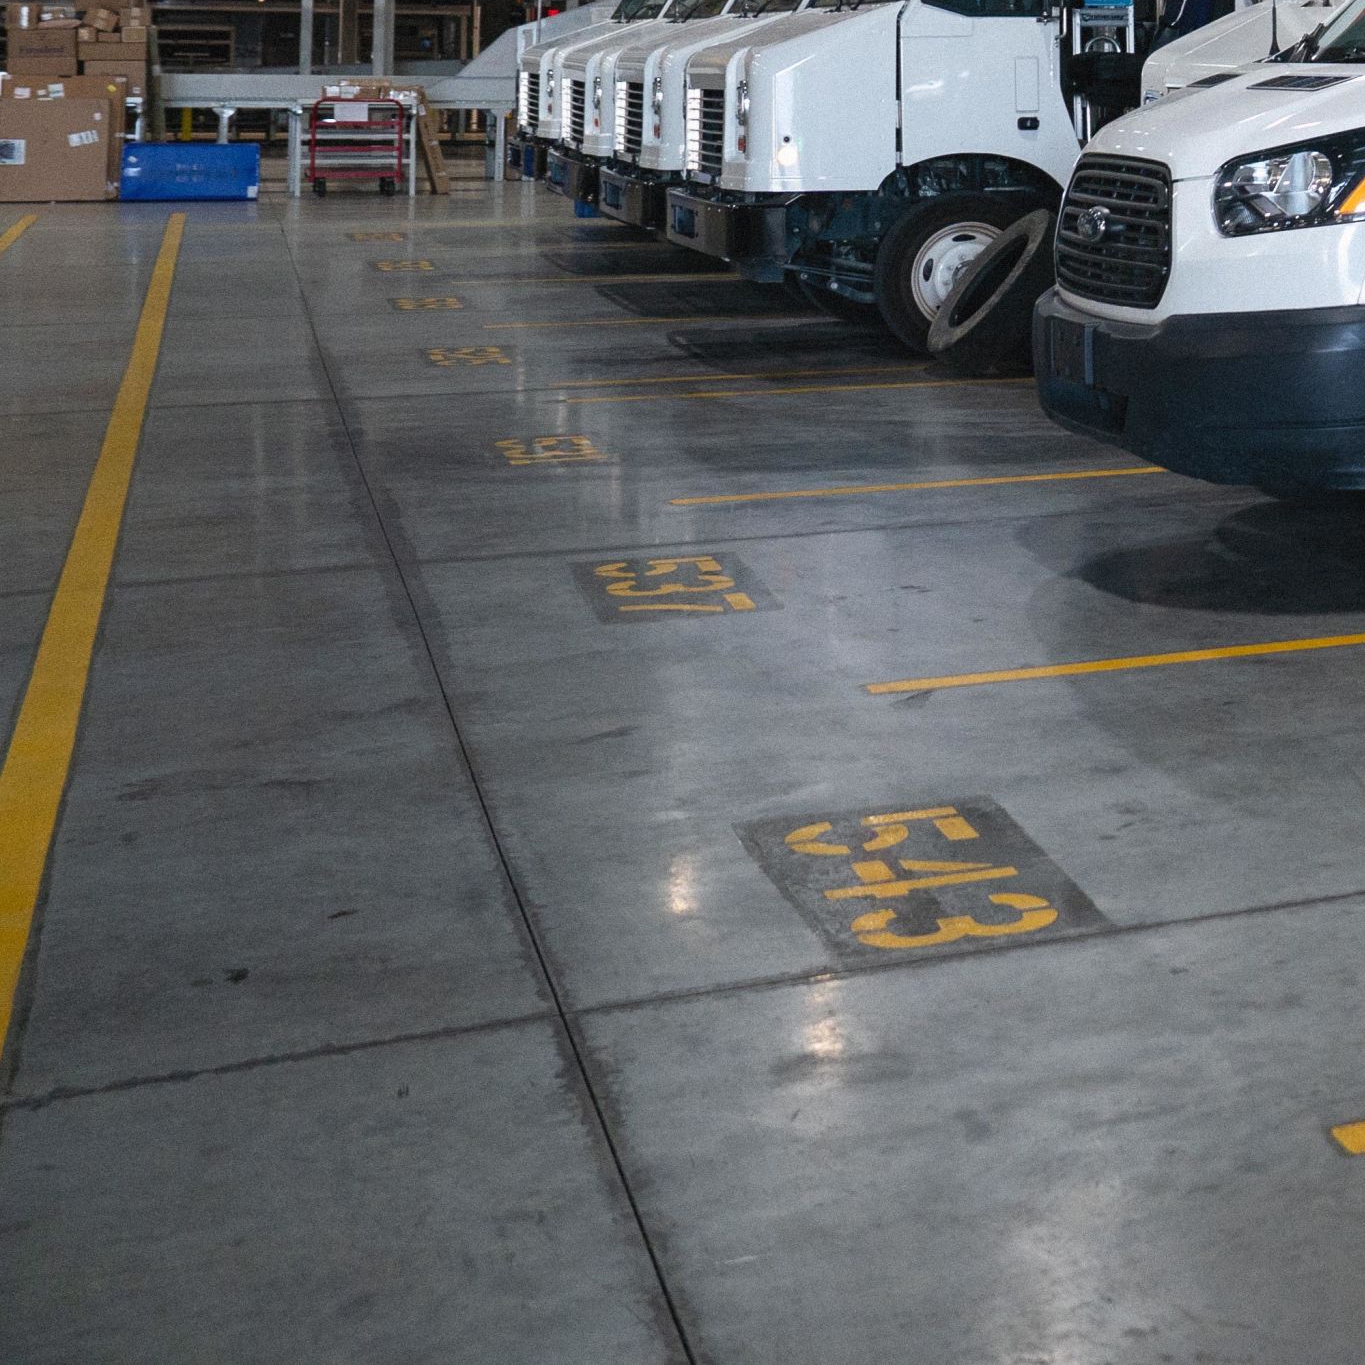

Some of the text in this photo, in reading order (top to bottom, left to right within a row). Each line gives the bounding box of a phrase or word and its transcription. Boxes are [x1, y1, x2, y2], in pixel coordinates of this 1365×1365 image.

[495, 435, 608, 466] 531
[594, 555, 757, 612] 537
[784, 805, 1059, 949] 543
